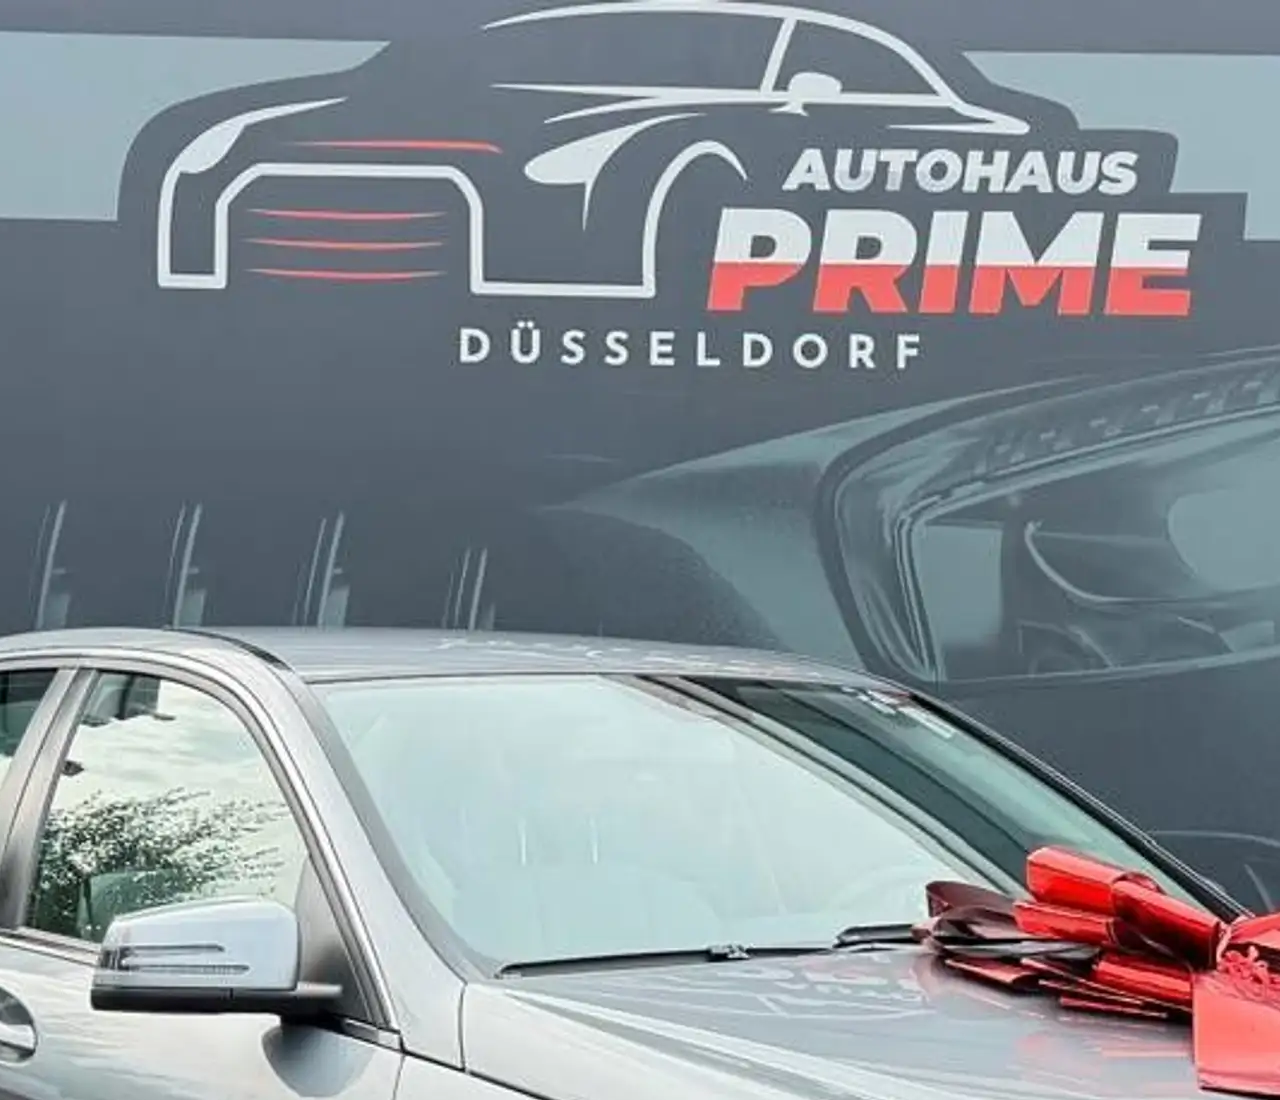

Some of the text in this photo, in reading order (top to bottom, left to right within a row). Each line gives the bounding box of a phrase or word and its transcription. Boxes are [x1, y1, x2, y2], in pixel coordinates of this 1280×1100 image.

[783, 146, 1139, 196] AUTOHAUS
[706, 206, 1203, 317] PRIME
[459, 321, 923, 370] DÜSSELDORF
